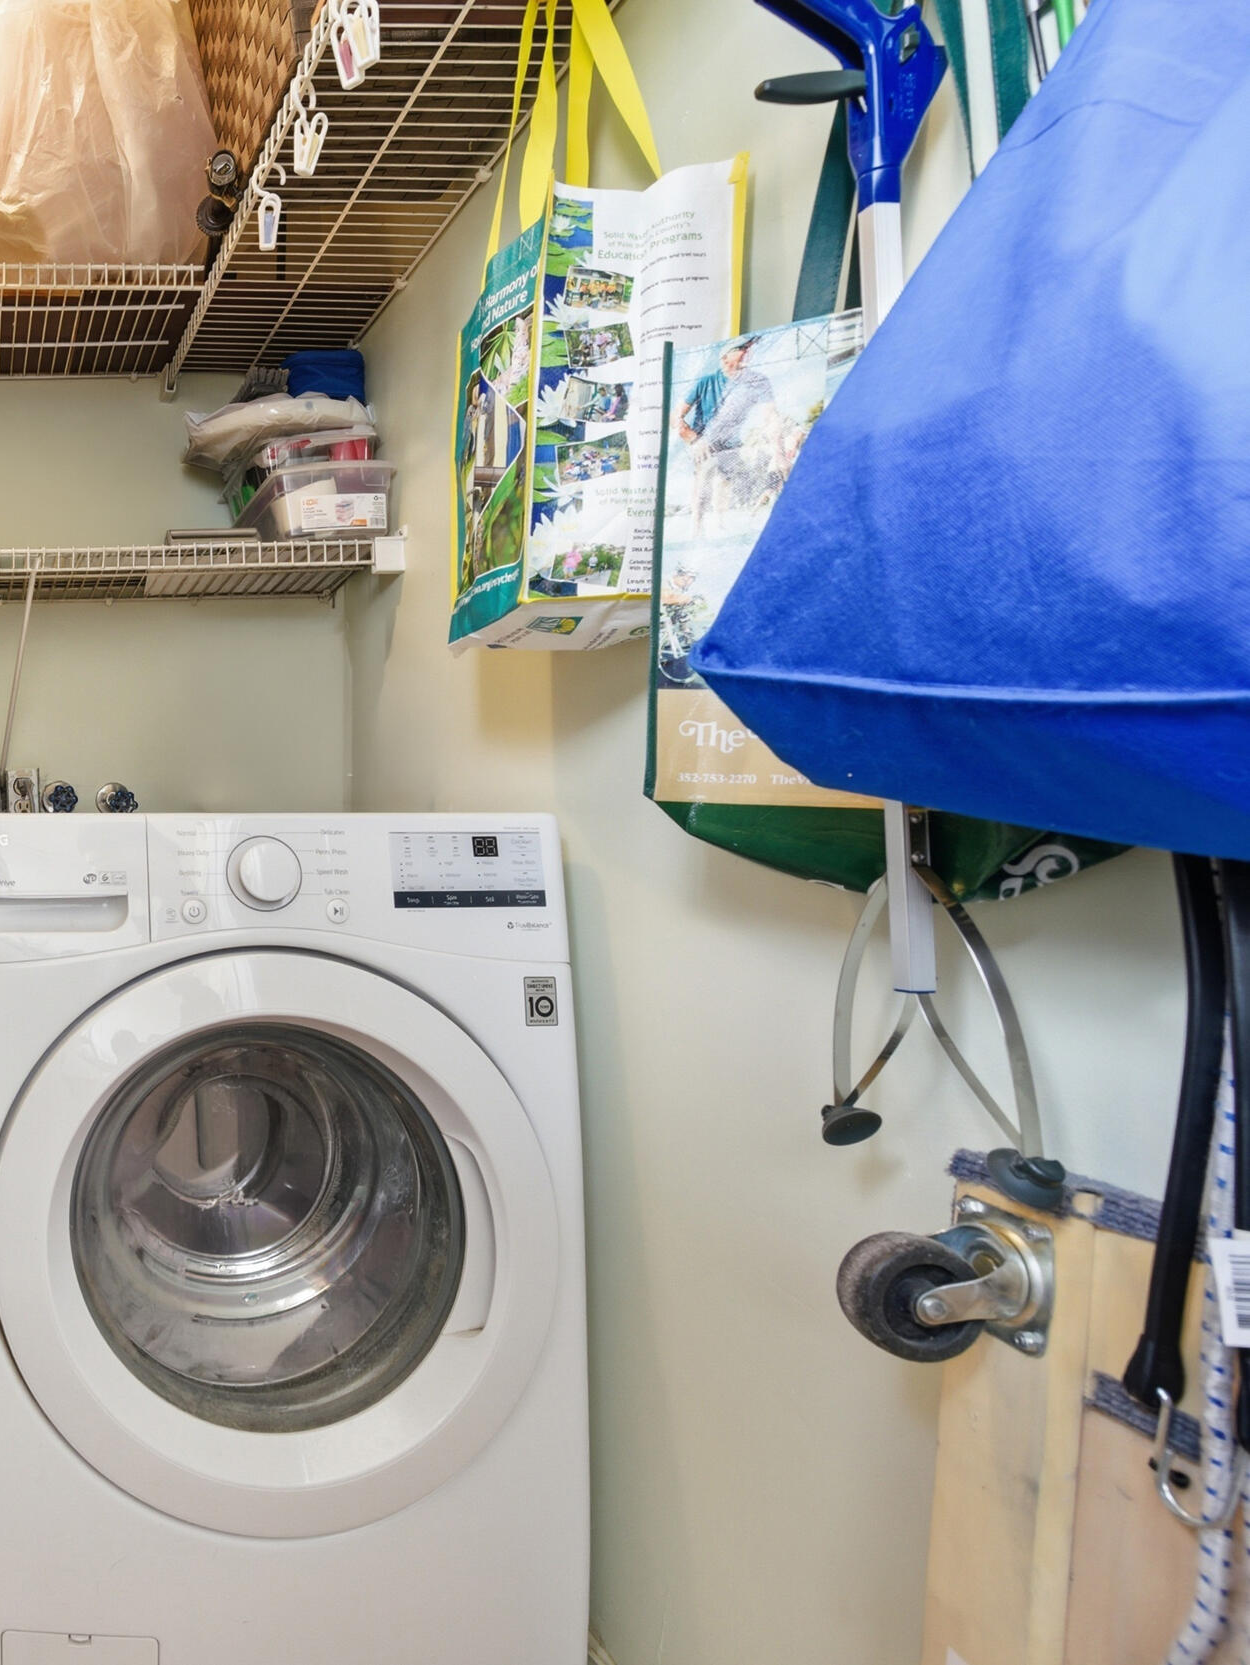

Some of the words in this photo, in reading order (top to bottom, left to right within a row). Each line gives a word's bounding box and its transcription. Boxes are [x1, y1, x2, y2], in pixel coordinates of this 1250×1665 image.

[679, 720, 745, 753] The
[678, 772, 757, 784] 352-753-2270
[529, 996, 554, 1017] 10
